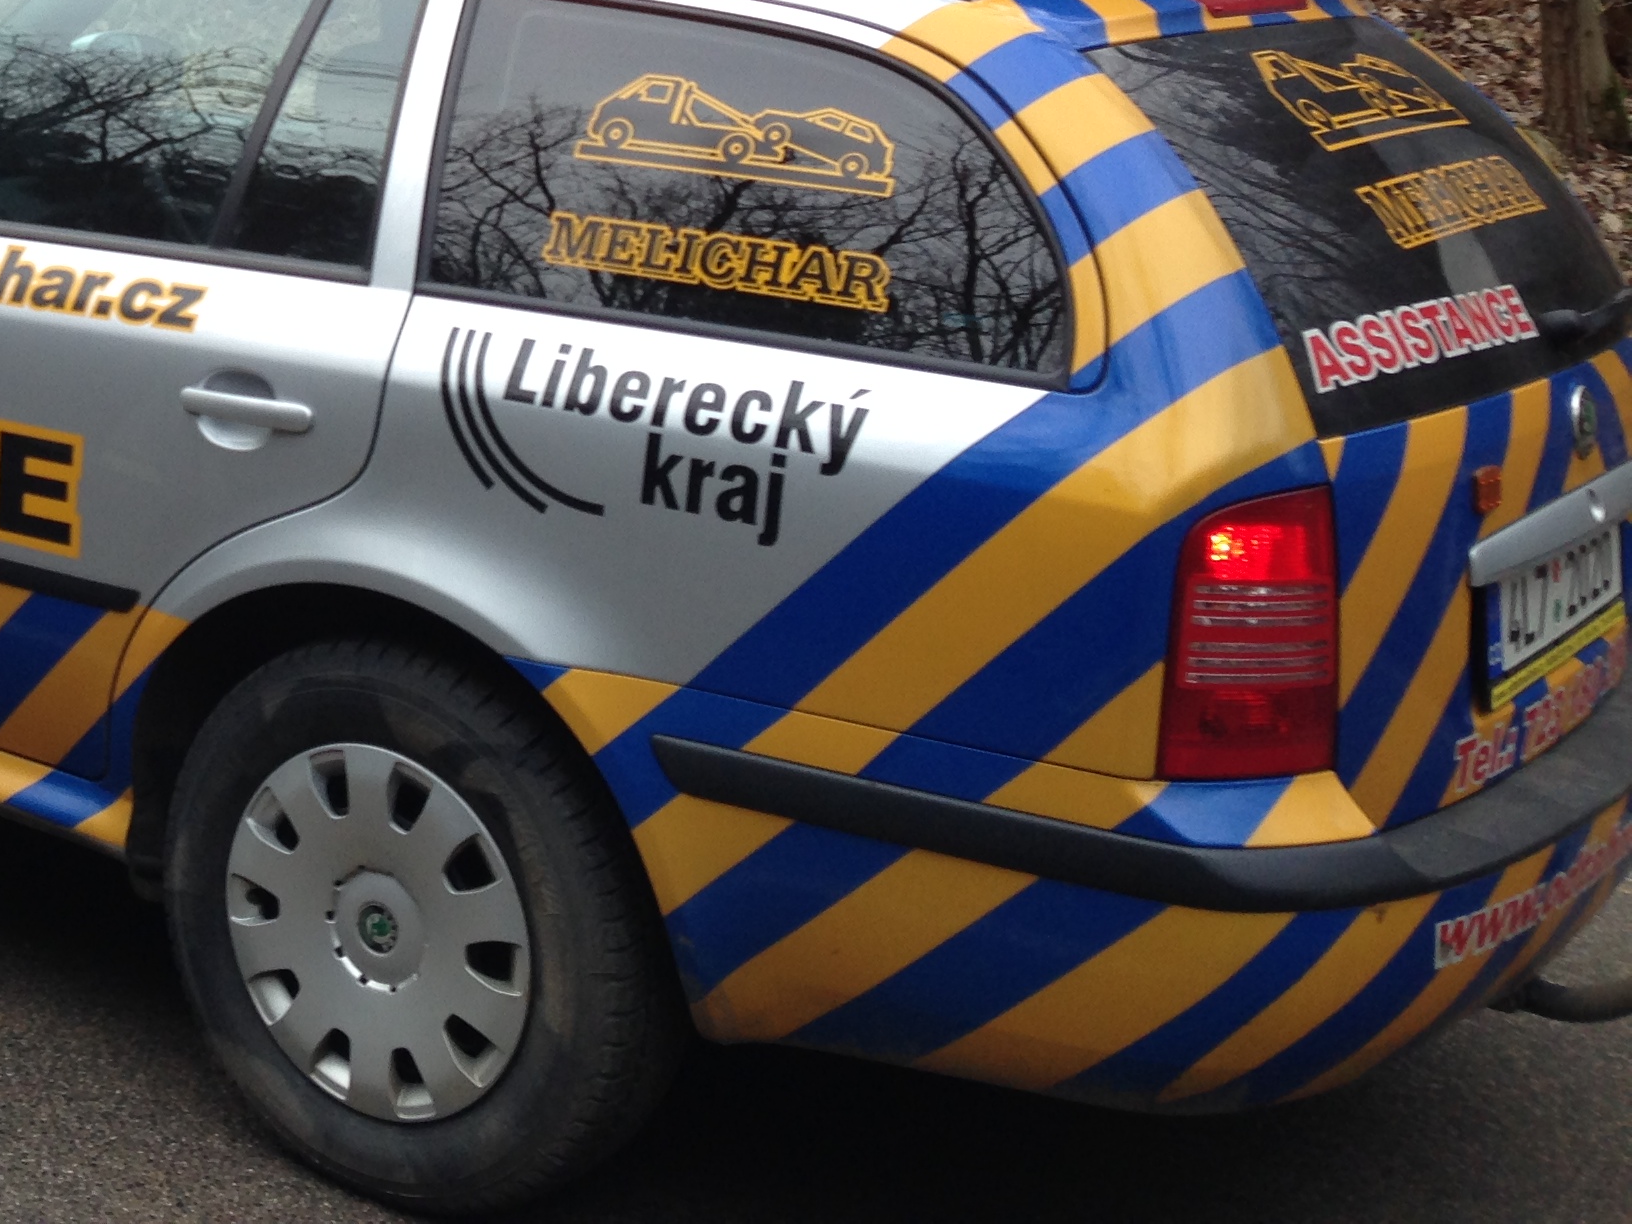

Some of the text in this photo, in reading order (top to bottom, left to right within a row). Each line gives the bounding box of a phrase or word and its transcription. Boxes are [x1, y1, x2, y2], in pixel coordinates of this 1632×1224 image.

[543, 211, 891, 312] MELICHAR
[1303, 284, 1539, 393] ASSISTANCE
[502, 337, 872, 476] Liberecký
[640, 432, 787, 546] kraj
